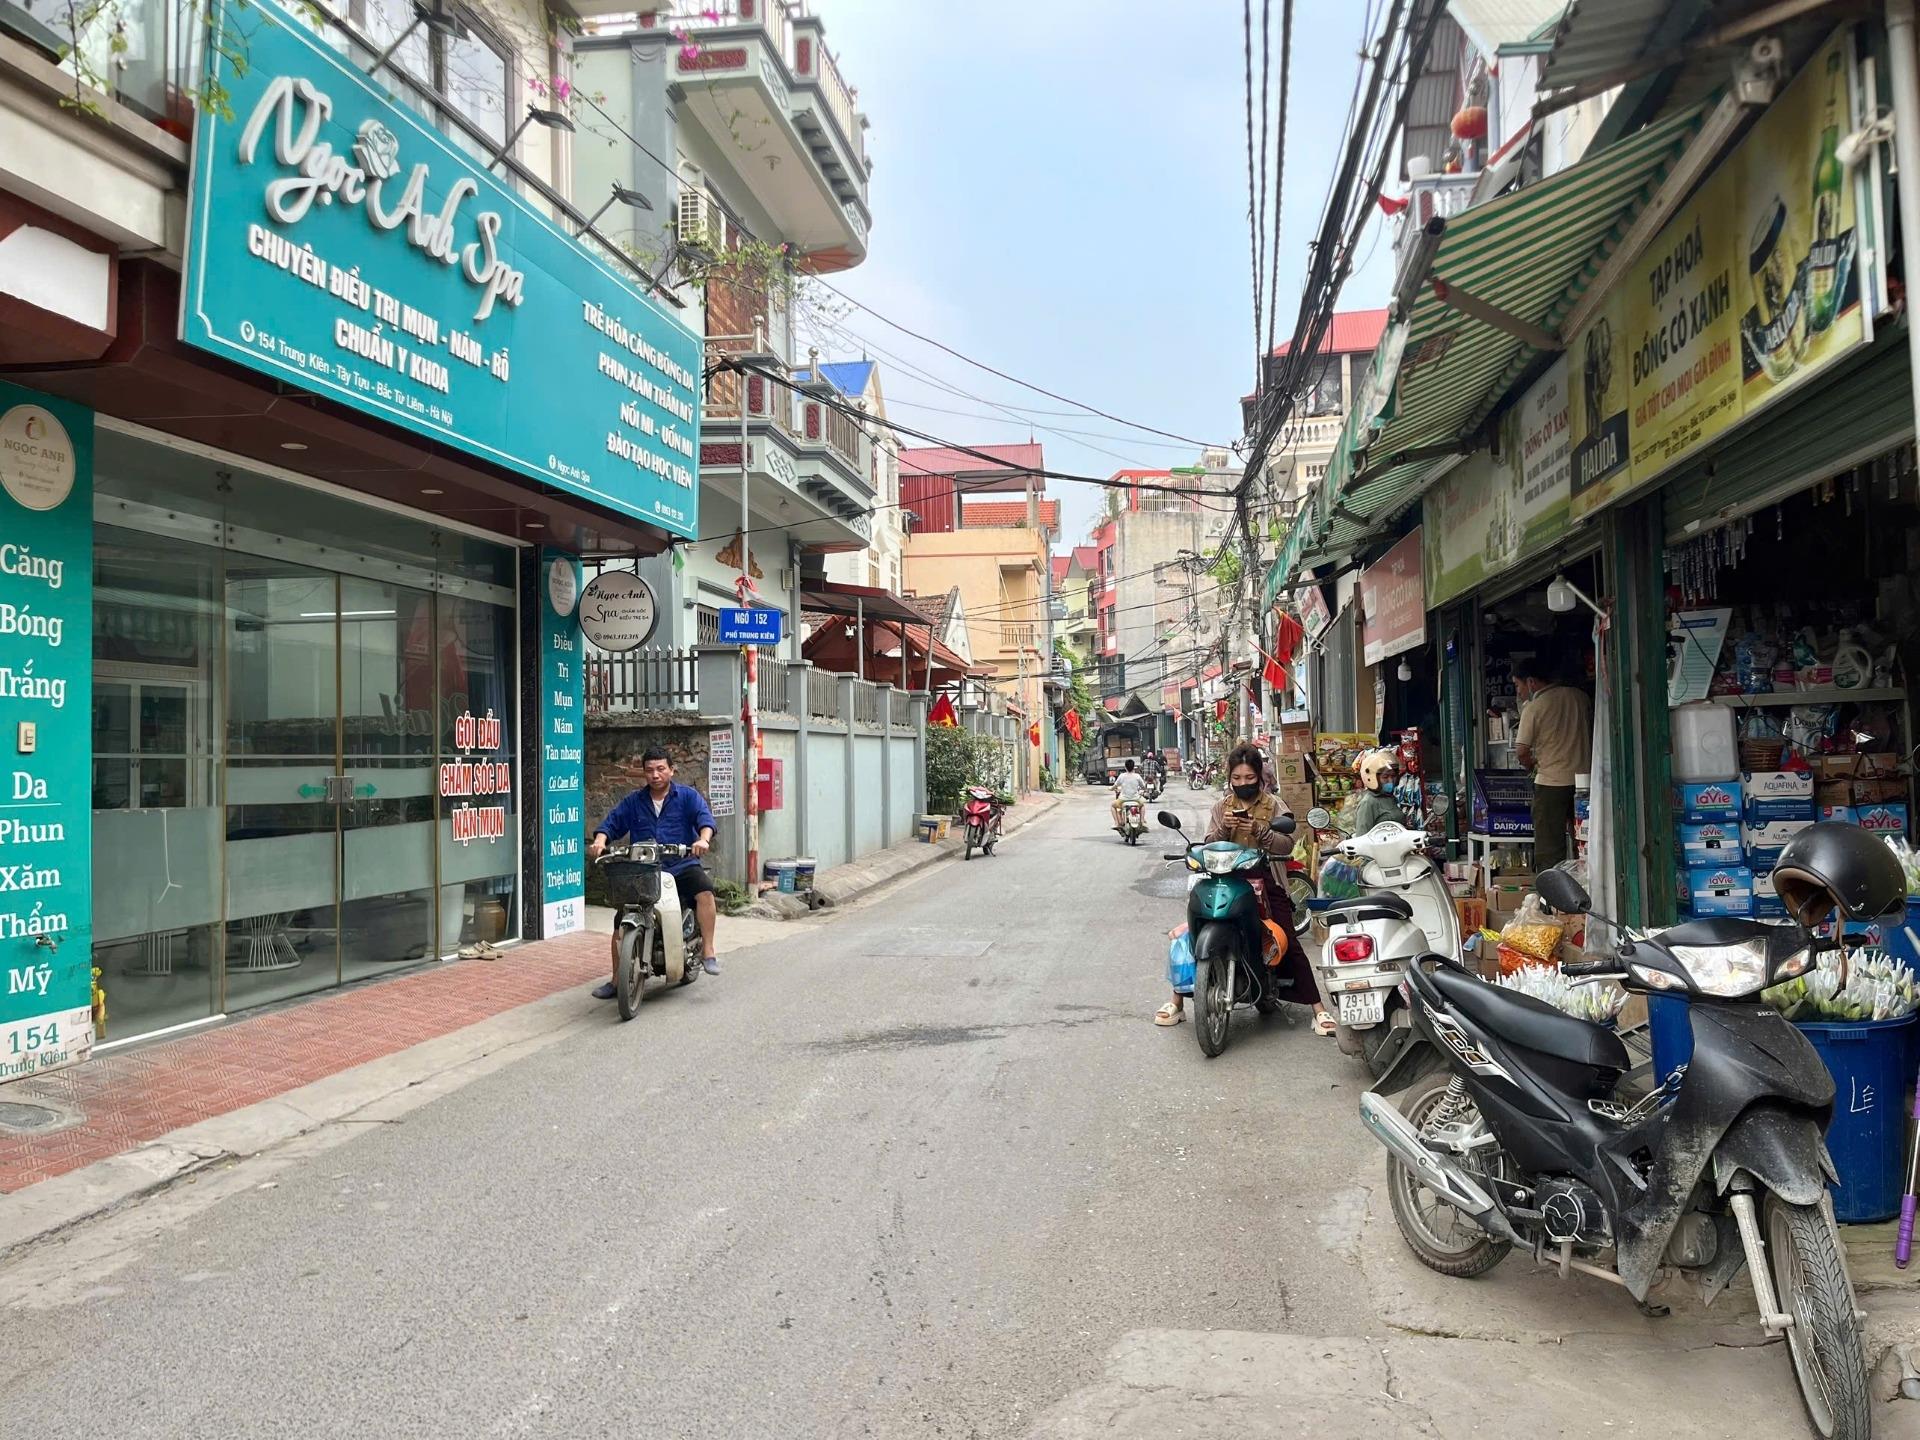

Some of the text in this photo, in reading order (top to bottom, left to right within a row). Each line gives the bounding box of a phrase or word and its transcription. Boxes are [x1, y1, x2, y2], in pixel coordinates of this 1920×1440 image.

[239, 76, 525, 321] Ngọc Anh Spa
[248, 223, 327, 290] CHUYÊN
[329, 266, 371, 311] ĐIỀU
[373, 288, 399, 332] TRỊ
[402, 304, 438, 346] MỤN
[449, 330, 482, 368] NÁM
[1648, 256, 1672, 312] TẠP
[1690, 268, 1731, 340] XANH
[257, 332, 275, 352] 154
[278, 339, 306, 368] Trung
[309, 352, 330, 374] Kiên
[335, 318, 449, 394] CHUẨN Y KHOA
[605, 317, 628, 349] HÓA
[682, 366, 695, 393] DA
[598, 352, 629, 386] PHUN
[620, 400, 640, 429] NỐI
[640, 411, 654, 437] MI
[681, 438, 693, 459] MI
[4, 438, 65, 462] NGỌC ANH
[606, 430, 631, 460] ĐÀO
[1580, 431, 1618, 486] HALIDA
[0, 544, 64, 589] Căng
[594, 588, 646, 601] Ngọc Anh
[0, 603, 64, 647] Bóng
[583, 603, 619, 623] Spa
[754, 613, 768, 625] 152
[738, 631, 759, 639] TRUNG
[0, 659, 67, 709] Trắng
[558, 662, 569, 682] Trị
[554, 690, 573, 710] Mụn
[455, 710, 475, 756] GỘI
[554, 718, 573, 734] Nám
[560, 746, 582, 764] nhang
[12, 771, 48, 800] Da
[440, 757, 511, 797] CHĂM SÓC DA
[1763, 781, 1799, 791] AQUAFINA
[478, 806, 505, 844] MỤN
[549, 803, 579, 825] Uốn Mi
[1493, 822, 1535, 831] DAIRY MIL
[0, 818, 65, 845] Phun
[550, 835, 578, 857] Nối Mi
[0, 862, 61, 892] Xăm
[565, 868, 582, 887] lông
[0, 901, 68, 938] Thẩm
[554, 920, 567, 932] Trung
[556, 903, 574, 920] 154
[8, 962, 52, 996] Mỹ
[1342, 1006, 1381, 1023] 367.08
[1344, 992, 1376, 1009] 29-L1
[8, 1021, 60, 1055] 154
[0, 1048, 68, 1079] Trung Kiên
